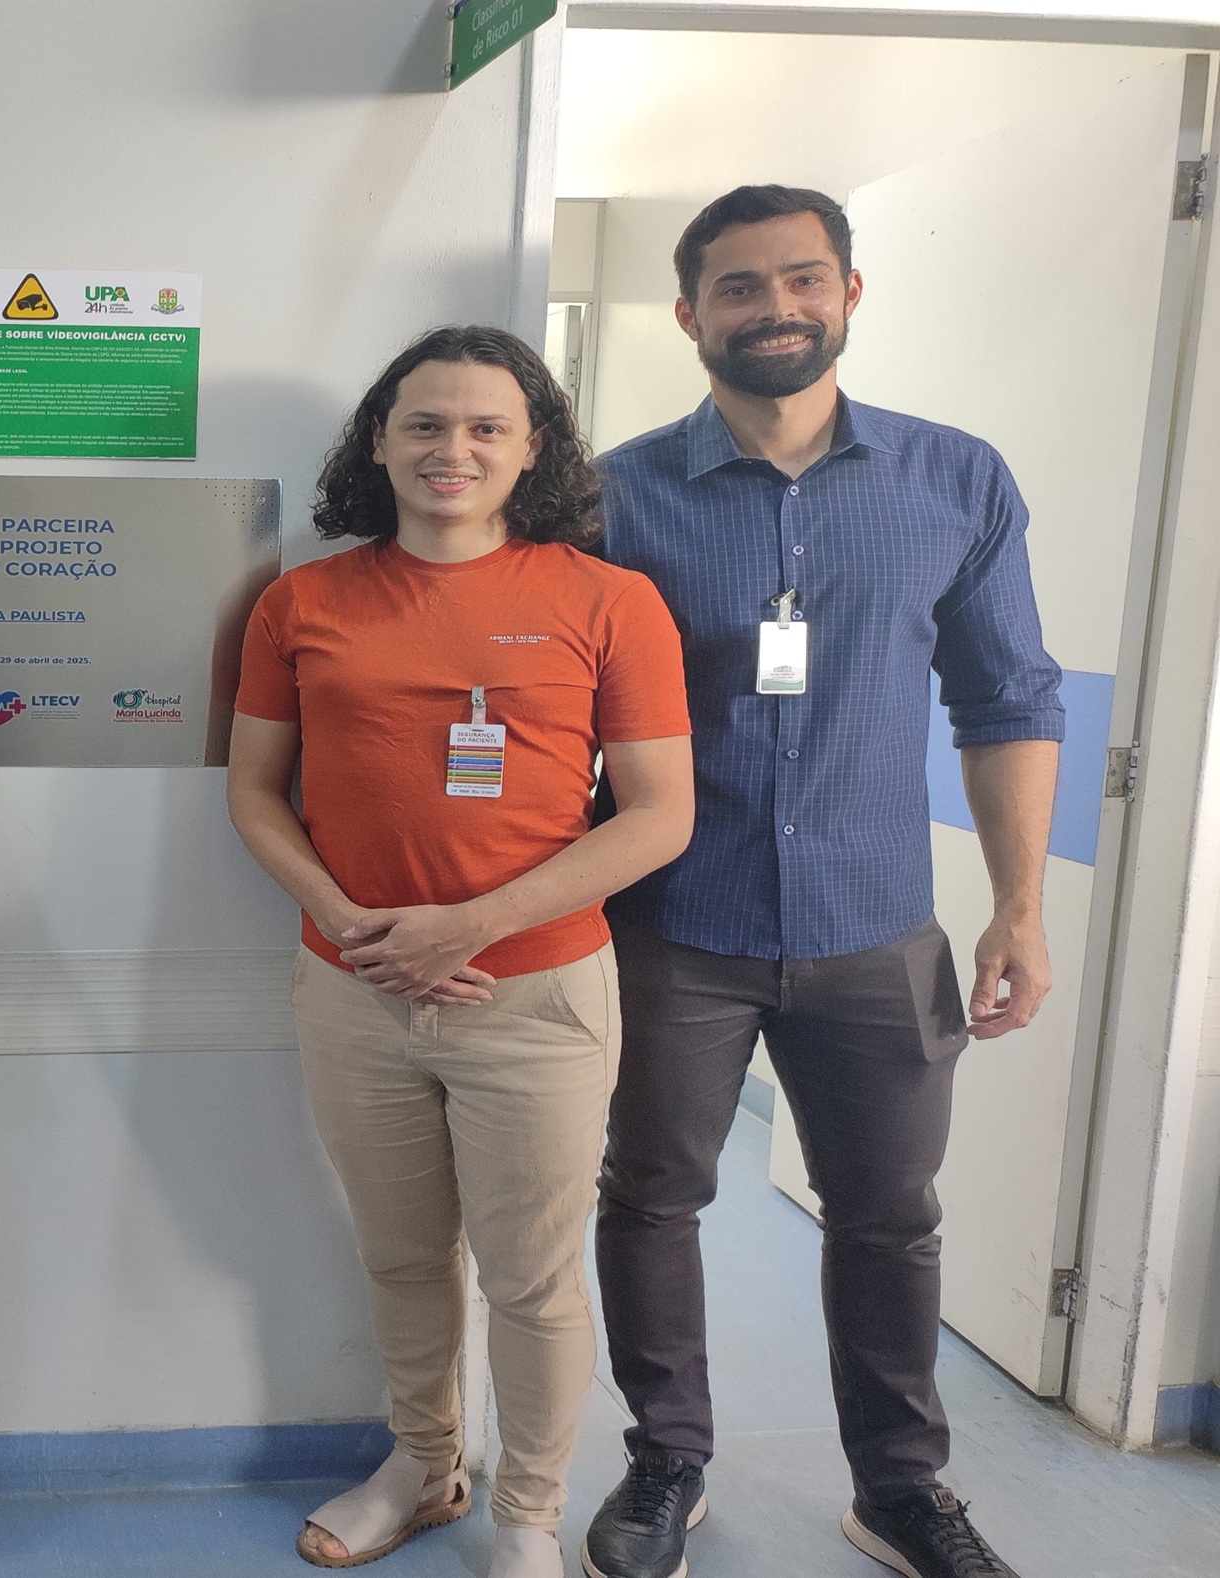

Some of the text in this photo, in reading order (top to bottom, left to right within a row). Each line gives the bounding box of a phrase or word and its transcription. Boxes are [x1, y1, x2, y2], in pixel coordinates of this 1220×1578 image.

[472, 4, 524, 59] de Risco 01
[85, 286, 130, 301] UPA
[84, 302, 107, 313] 24h
[6, 331, 44, 339] SOBRE
[47, 330, 146, 341] VÍDEOVIGILÂNCIA
[148, 333, 186, 343] (CCTV)
[2, 518, 115, 533] PARCEIRA
[0, 540, 103, 555] PROJETO
[5, 559, 117, 580] CORAÇÃO
[10, 610, 86, 621] PAULISTA
[13, 656, 26, 664] de
[28, 656, 50, 664] abril
[66, 657, 91, 665] 2025.
[32, 696, 80, 706] LTECV
[144, 693, 181, 708] Hospital
[116, 708, 181, 718] Maria Lucinda
